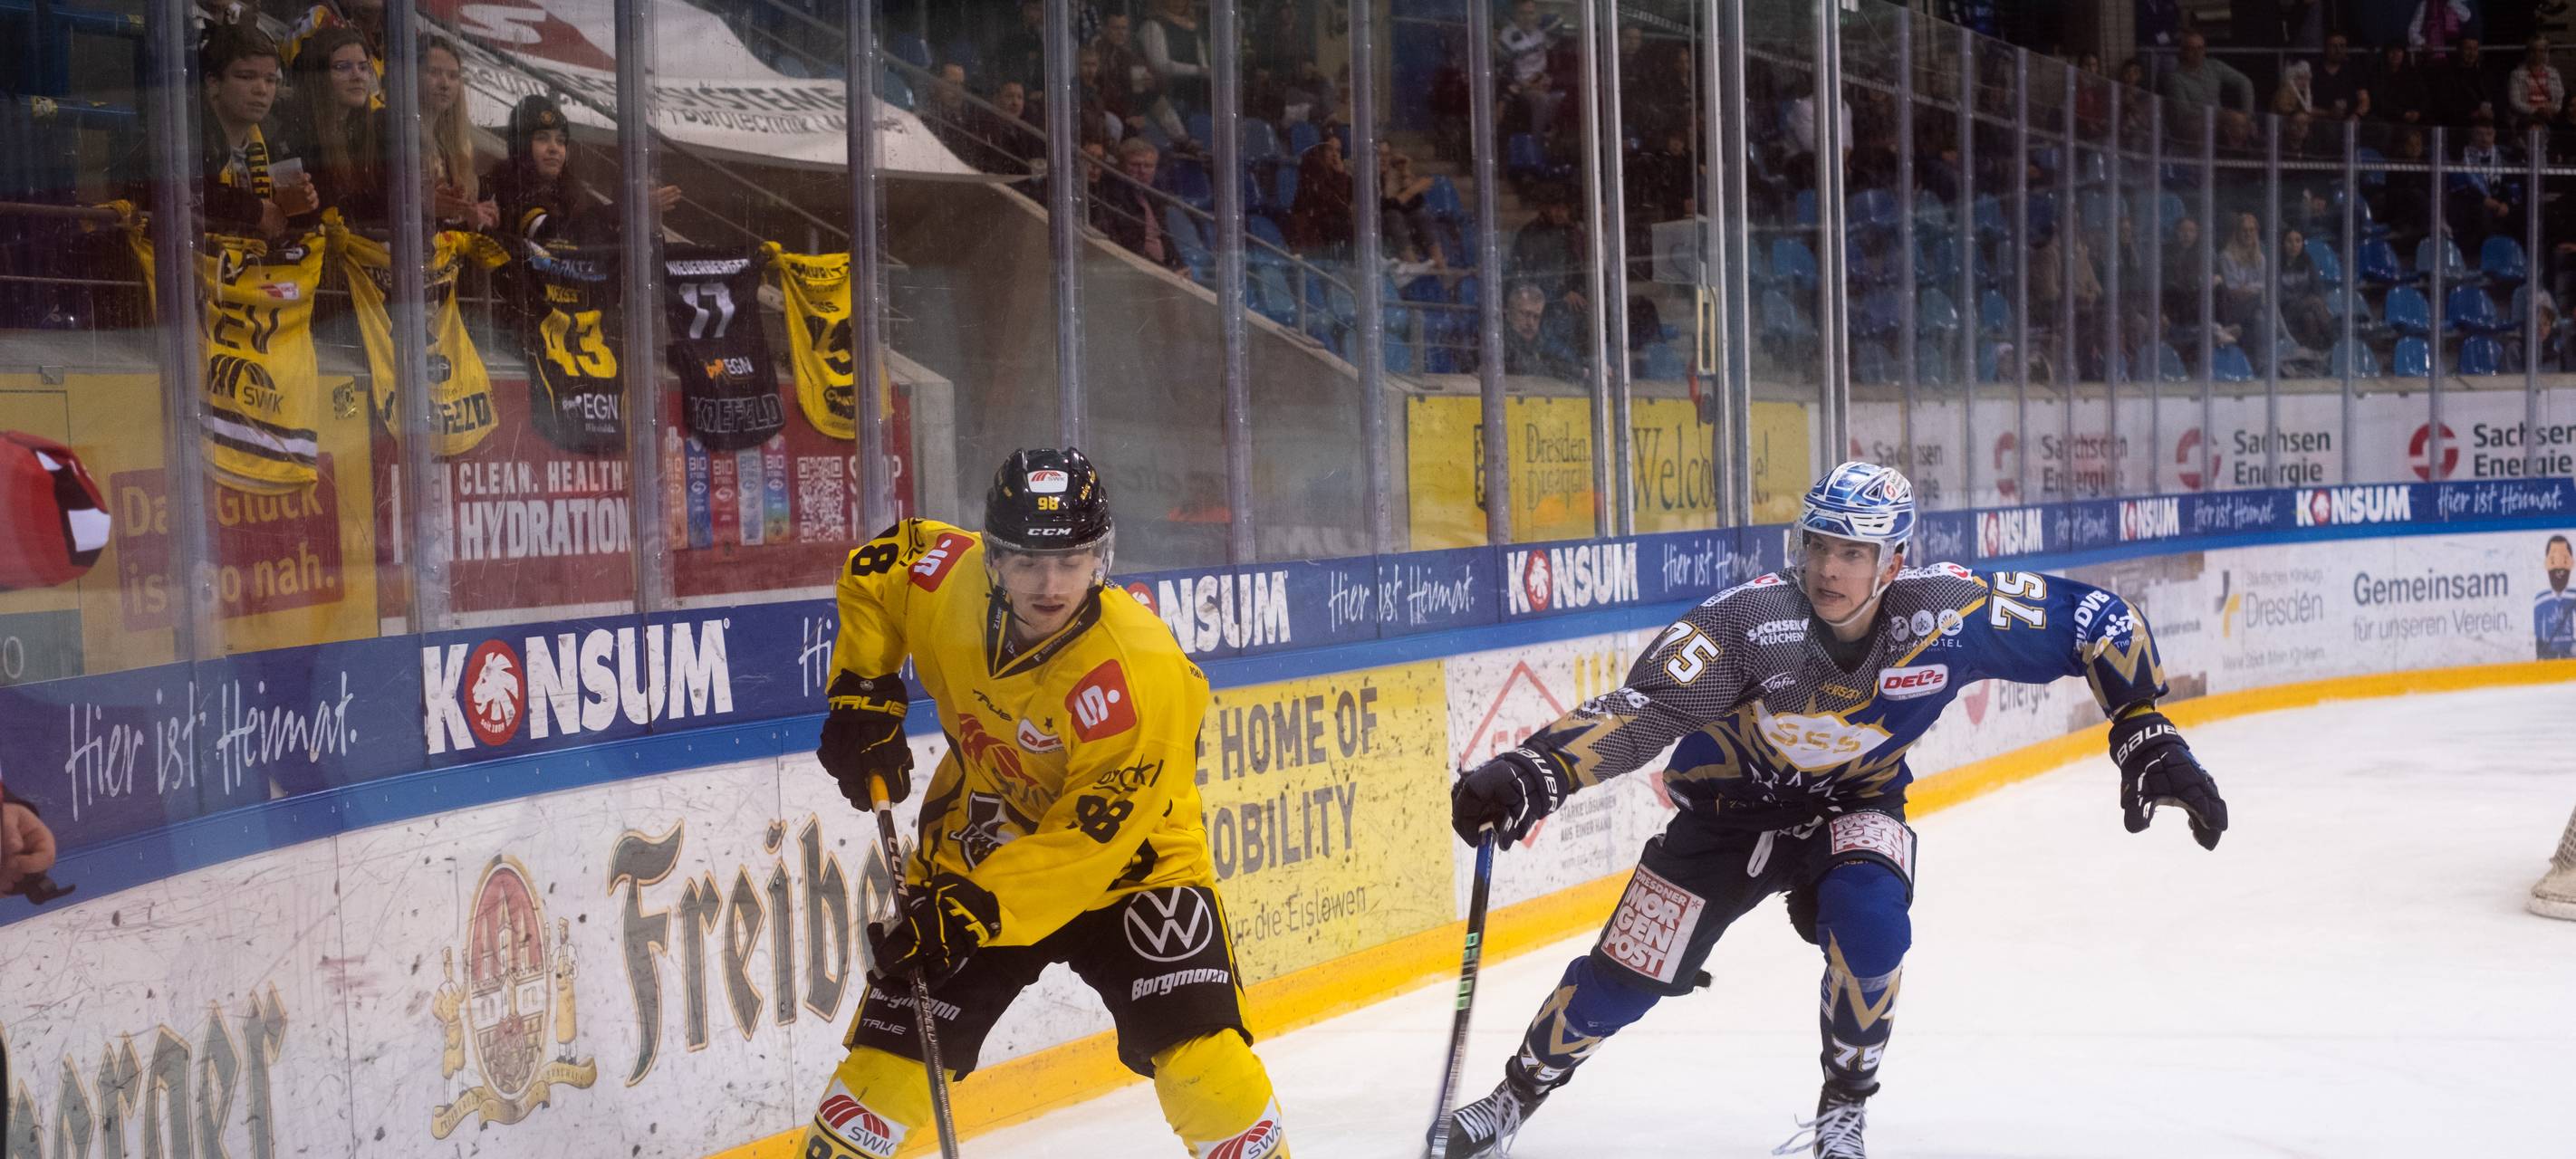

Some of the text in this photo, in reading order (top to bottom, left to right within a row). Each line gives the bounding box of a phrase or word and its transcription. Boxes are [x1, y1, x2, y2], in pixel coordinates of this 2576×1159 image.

[679, 283, 735, 339] 17
[540, 308, 618, 378] 43
[243, 387, 284, 414] SWK
[583, 393, 619, 420] EGN
[459, 460, 630, 495] CLEAN. HEALTH
[1632, 424, 1770, 512] Welcoe!
[121, 486, 168, 538] Da
[1037, 496, 1059, 511] 98
[2295, 485, 2411, 527] KONSUM
[2437, 485, 2470, 522] Hier
[2474, 484, 2498, 513] ist
[460, 498, 632, 560] HYDRATION
[1027, 527, 1072, 536] CCM
[254, 541, 334, 599] nah.
[1507, 541, 1639, 616] KONSUM
[2353, 568, 2509, 606] Gemeinsam
[1328, 564, 1475, 632] Hier ist Heimat.
[1991, 571, 2047, 631] 75
[2074, 590, 2111, 628] DVB
[2246, 589, 2323, 628] Dresden
[2379, 612, 2446, 640] unseren
[2451, 606, 2514, 633] Verein.
[1646, 620, 1724, 686] 75
[422, 618, 735, 755] KONSUM
[828, 695, 907, 717] TRUE
[65, 671, 358, 822] Hier ist Heimat.
[1219, 694, 1327, 781] HOME
[1336, 686, 1378, 759] OF
[1200, 781, 1357, 880] OBILITY
[887, 836, 910, 896] CCM
[1636, 869, 1688, 906] DRESDNER
[1255, 905, 1282, 943] die
[1288, 885, 1367, 934] Eislöwen
[1617, 905, 1676, 953] GEN
[1626, 881, 1681, 930] MOR
[1605, 925, 1666, 973] POST
[1131, 968, 1229, 1001] Borgmann
[862, 1018, 907, 1035] TRUE
[1831, 1034, 1887, 1072] 75
[848, 1125, 895, 1156] SWK
[1248, 1117, 1282, 1159] SWK
